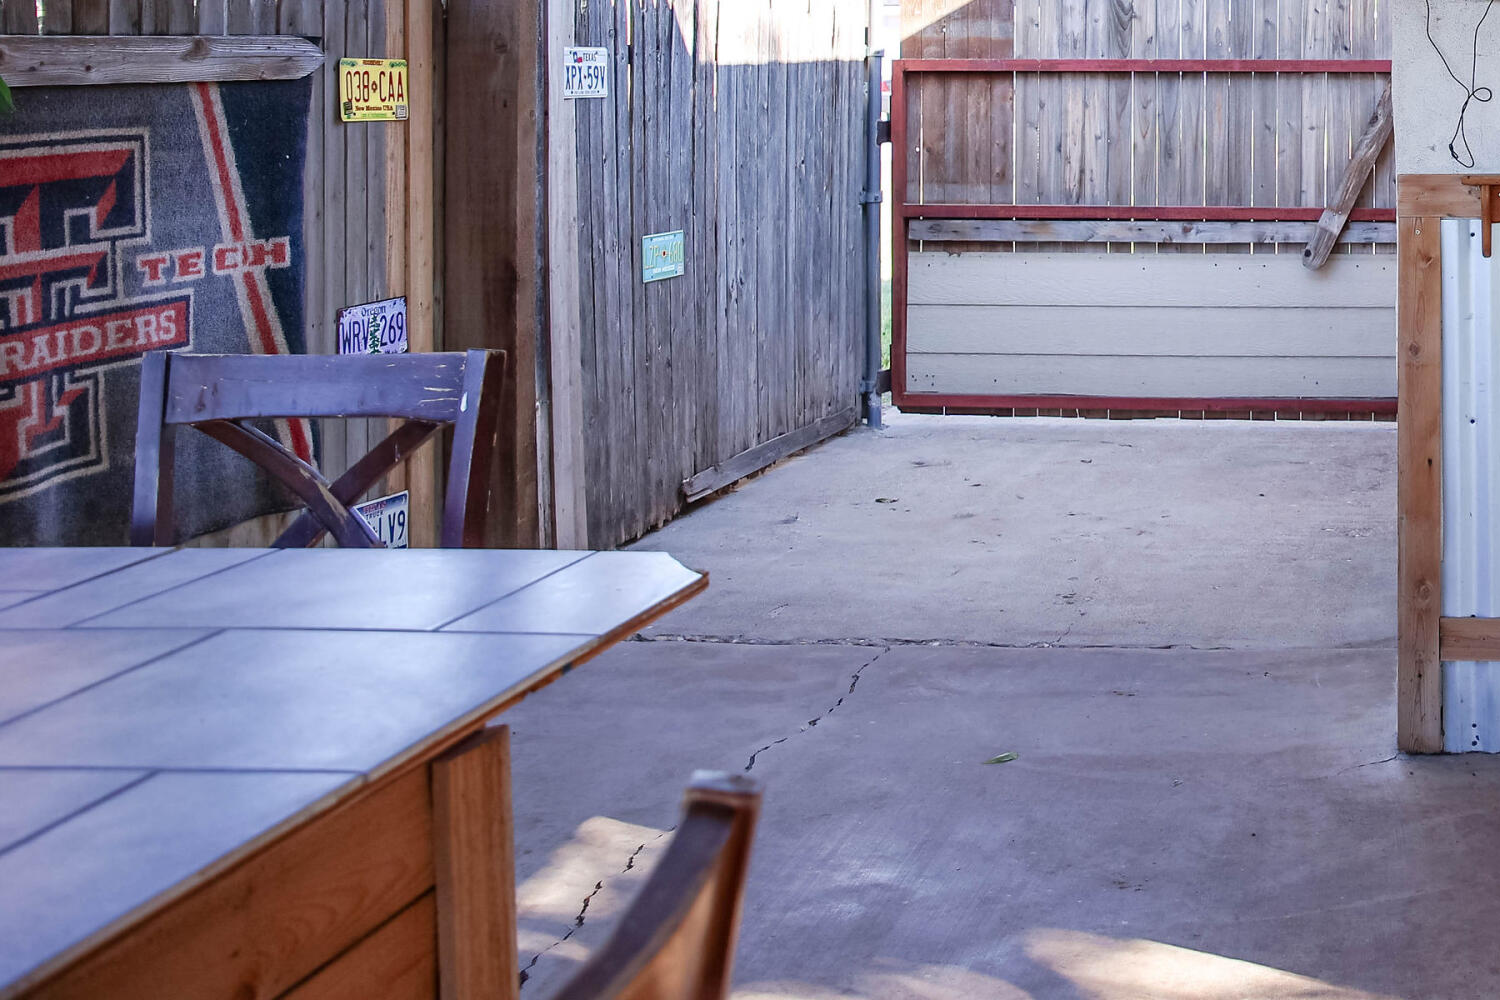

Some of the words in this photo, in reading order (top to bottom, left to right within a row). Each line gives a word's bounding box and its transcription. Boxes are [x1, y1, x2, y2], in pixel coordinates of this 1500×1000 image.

[583, 53, 597, 61] TEXAS
[137, 235, 290, 287] TECH
[361, 305, 386, 317] Oregon
[0, 310, 176, 376] RAIDERS
